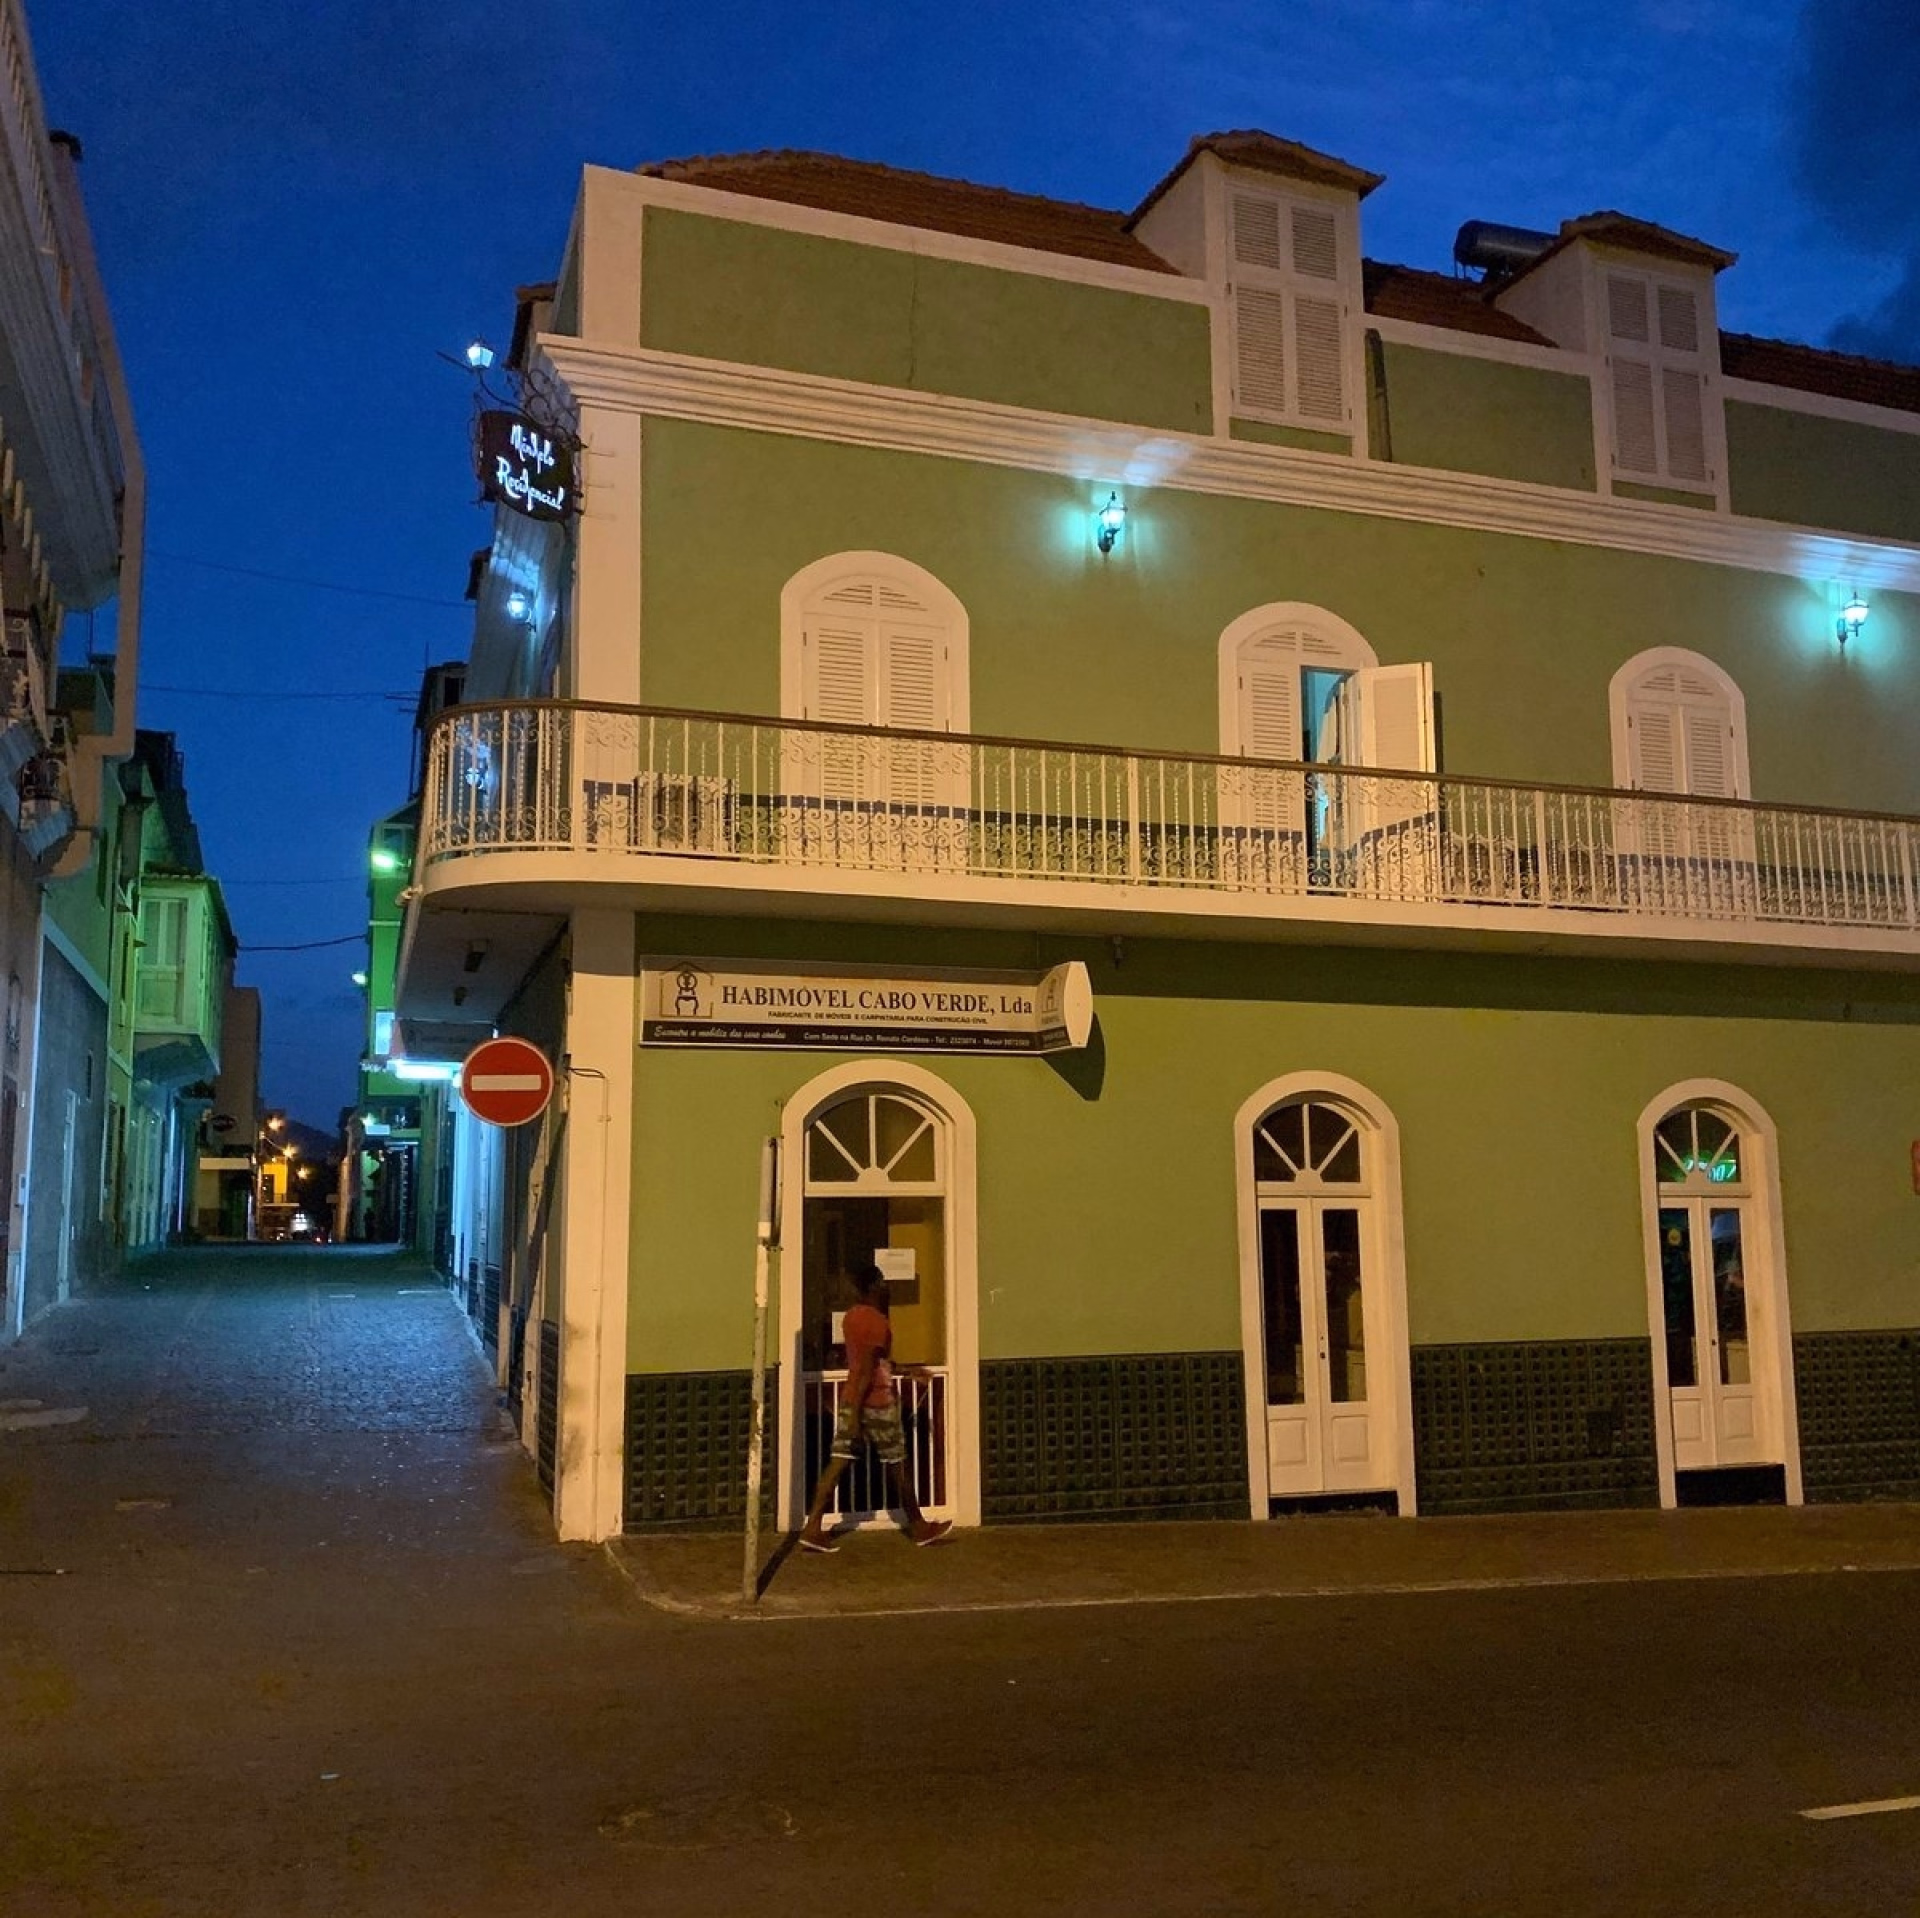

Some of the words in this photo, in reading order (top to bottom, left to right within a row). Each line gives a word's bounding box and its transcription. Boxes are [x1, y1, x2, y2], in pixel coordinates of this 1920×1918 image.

[722, 985, 854, 1008] HABIMÓVEL
[858, 990, 916, 1010] CABO
[921, 992, 995, 1016] VERDE,
[999, 996, 1033, 1014] Lda
[814, 1012, 825, 1020] DE
